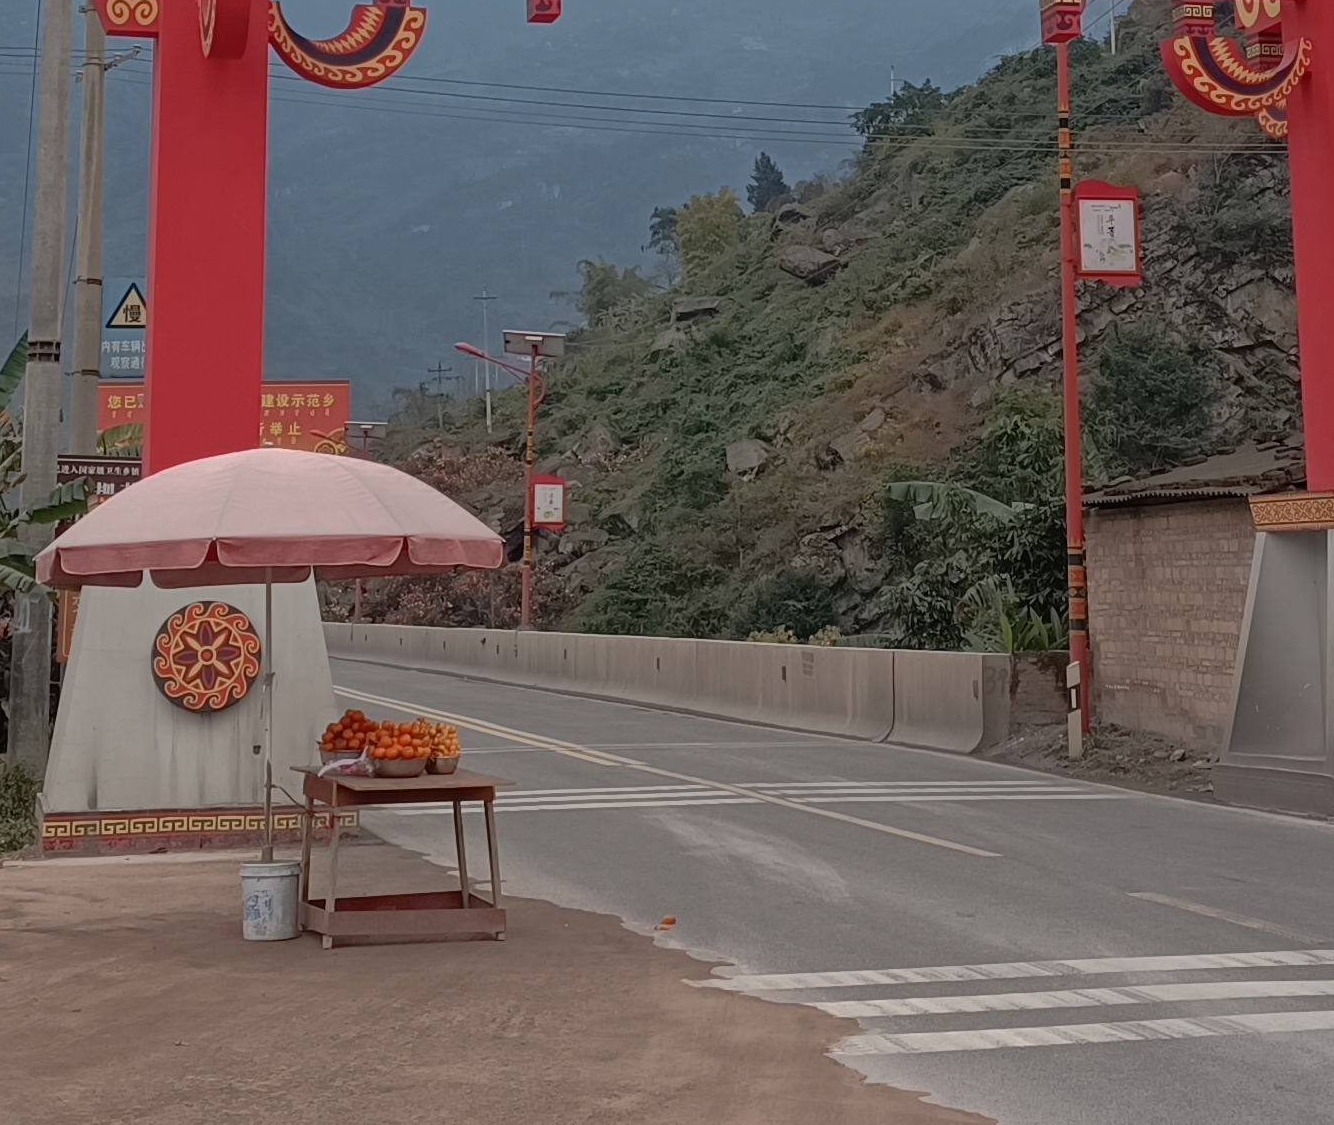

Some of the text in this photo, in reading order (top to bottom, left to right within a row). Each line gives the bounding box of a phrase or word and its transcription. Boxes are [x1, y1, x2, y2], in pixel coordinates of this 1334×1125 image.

[123, 304, 141, 323] 慢
[107, 393, 334, 409] 您已 建设示范乡
